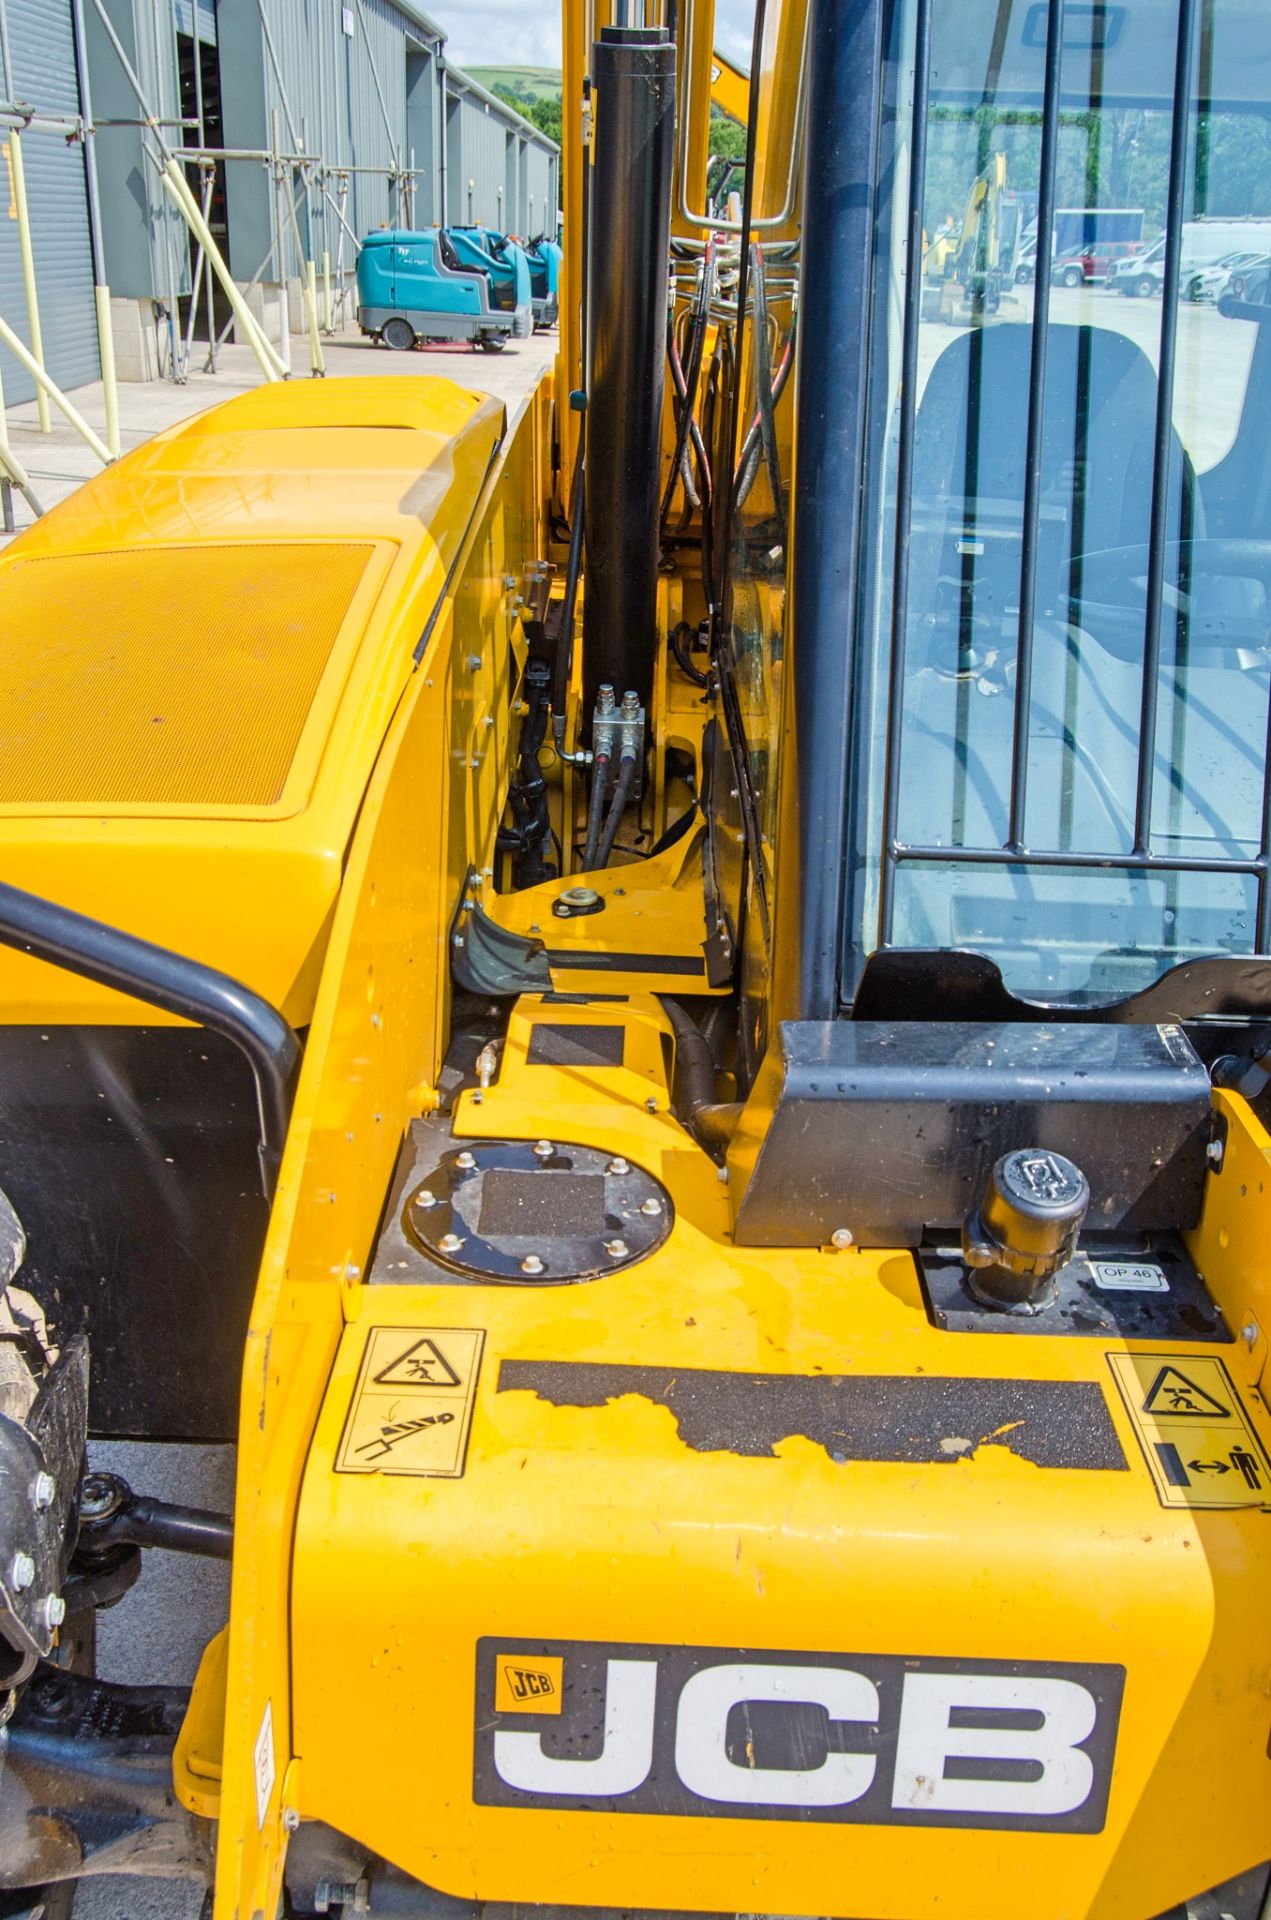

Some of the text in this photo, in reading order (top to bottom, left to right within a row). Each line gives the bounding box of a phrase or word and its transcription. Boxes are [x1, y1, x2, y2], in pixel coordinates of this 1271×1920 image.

[1104, 1268, 1152, 1278] OP 46
[513, 1669, 551, 1698] JCB
[493, 1659, 1098, 1815] JCB
